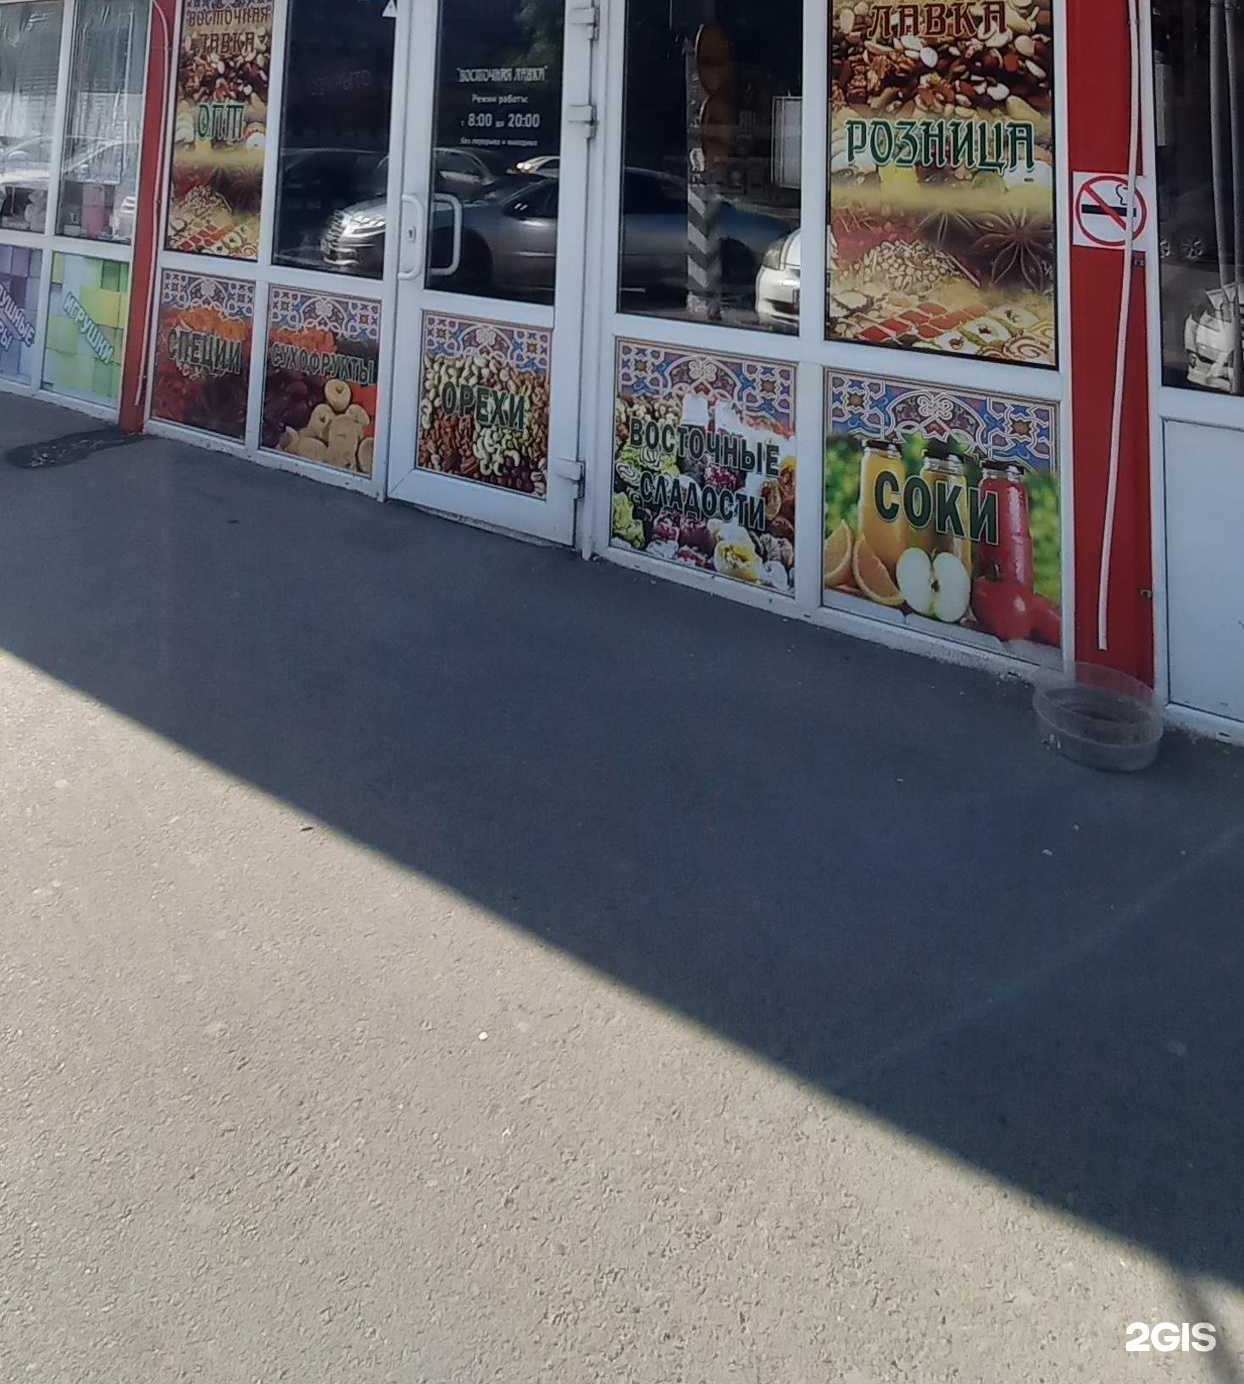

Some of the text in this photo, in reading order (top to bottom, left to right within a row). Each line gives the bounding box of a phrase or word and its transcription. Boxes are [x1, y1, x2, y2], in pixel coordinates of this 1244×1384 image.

[184, 7, 271, 27] ВОСТОЧНАЯ
[866, 0, 1009, 39] ЛАВКА
[194, 31, 256, 55] ЛАВКА
[197, 103, 246, 140] ОПТ
[467, 113, 493, 127] 8:00
[507, 113, 541, 128] 20:00
[845, 117, 1036, 173] РОЗНИЦА
[63, 292, 115, 366] ИГРУШКИ
[167, 327, 243, 375] СПЕЦИИ
[270, 342, 376, 385] СУХОФРУКТЫ
[442, 380, 527, 431] ОРЕХИ
[629, 417, 780, 476] ВОСТОЧНЫЕ
[639, 474, 768, 530] СЛАДОСТИ
[874, 470, 999, 545] СОКИ
